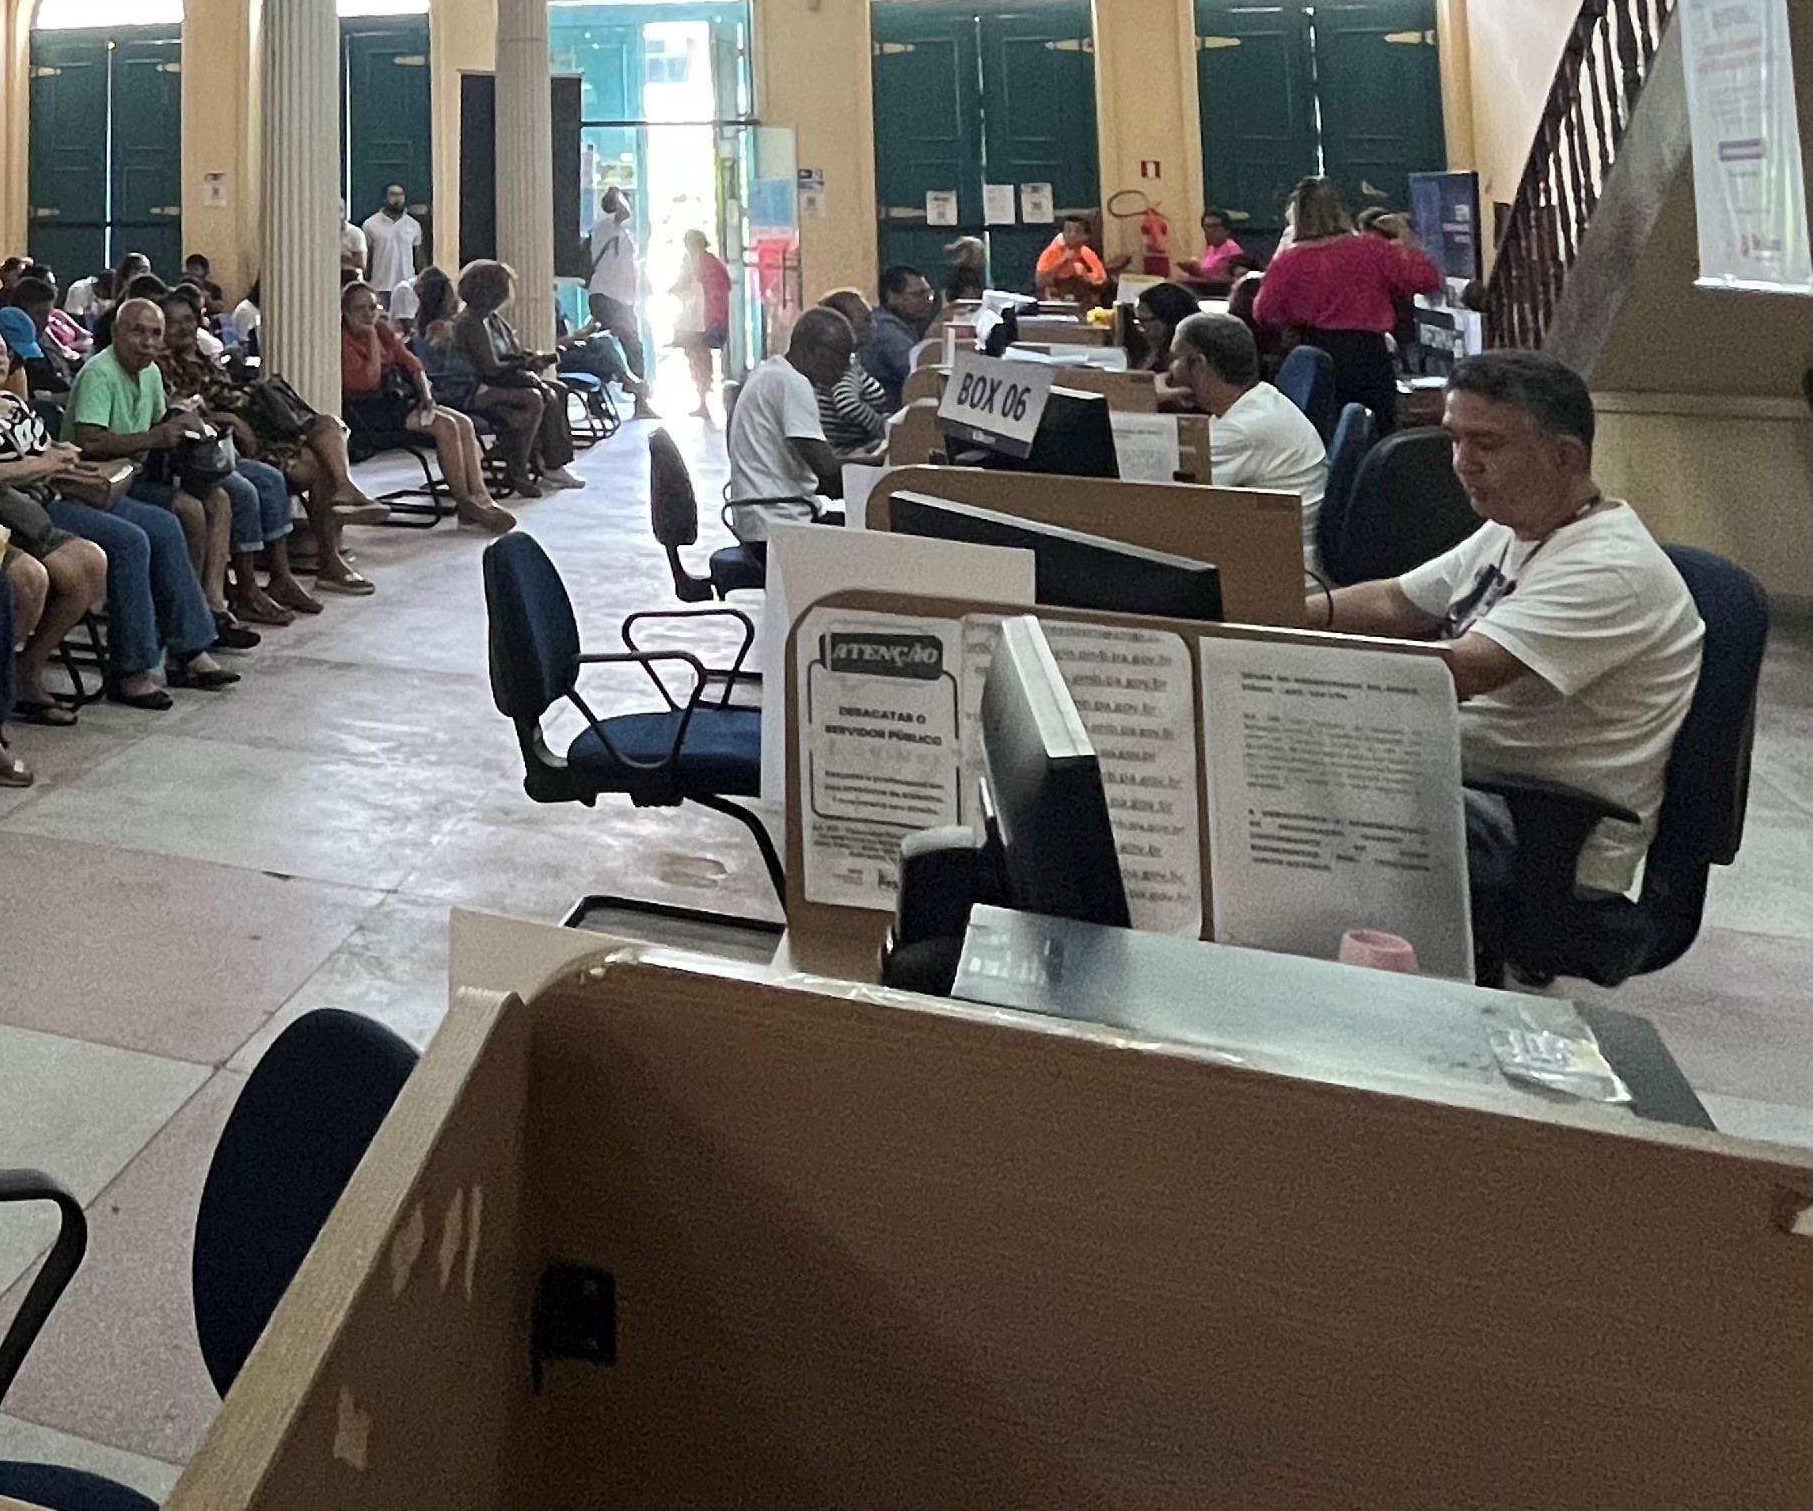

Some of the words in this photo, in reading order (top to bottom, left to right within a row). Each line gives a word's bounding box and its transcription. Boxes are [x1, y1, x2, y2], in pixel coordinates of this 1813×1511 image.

[957, 372, 1002, 414] BOX
[1002, 384, 1031, 421] 06
[831, 642, 940, 668] ATENÇÃO
[915, 713, 927, 725] O
